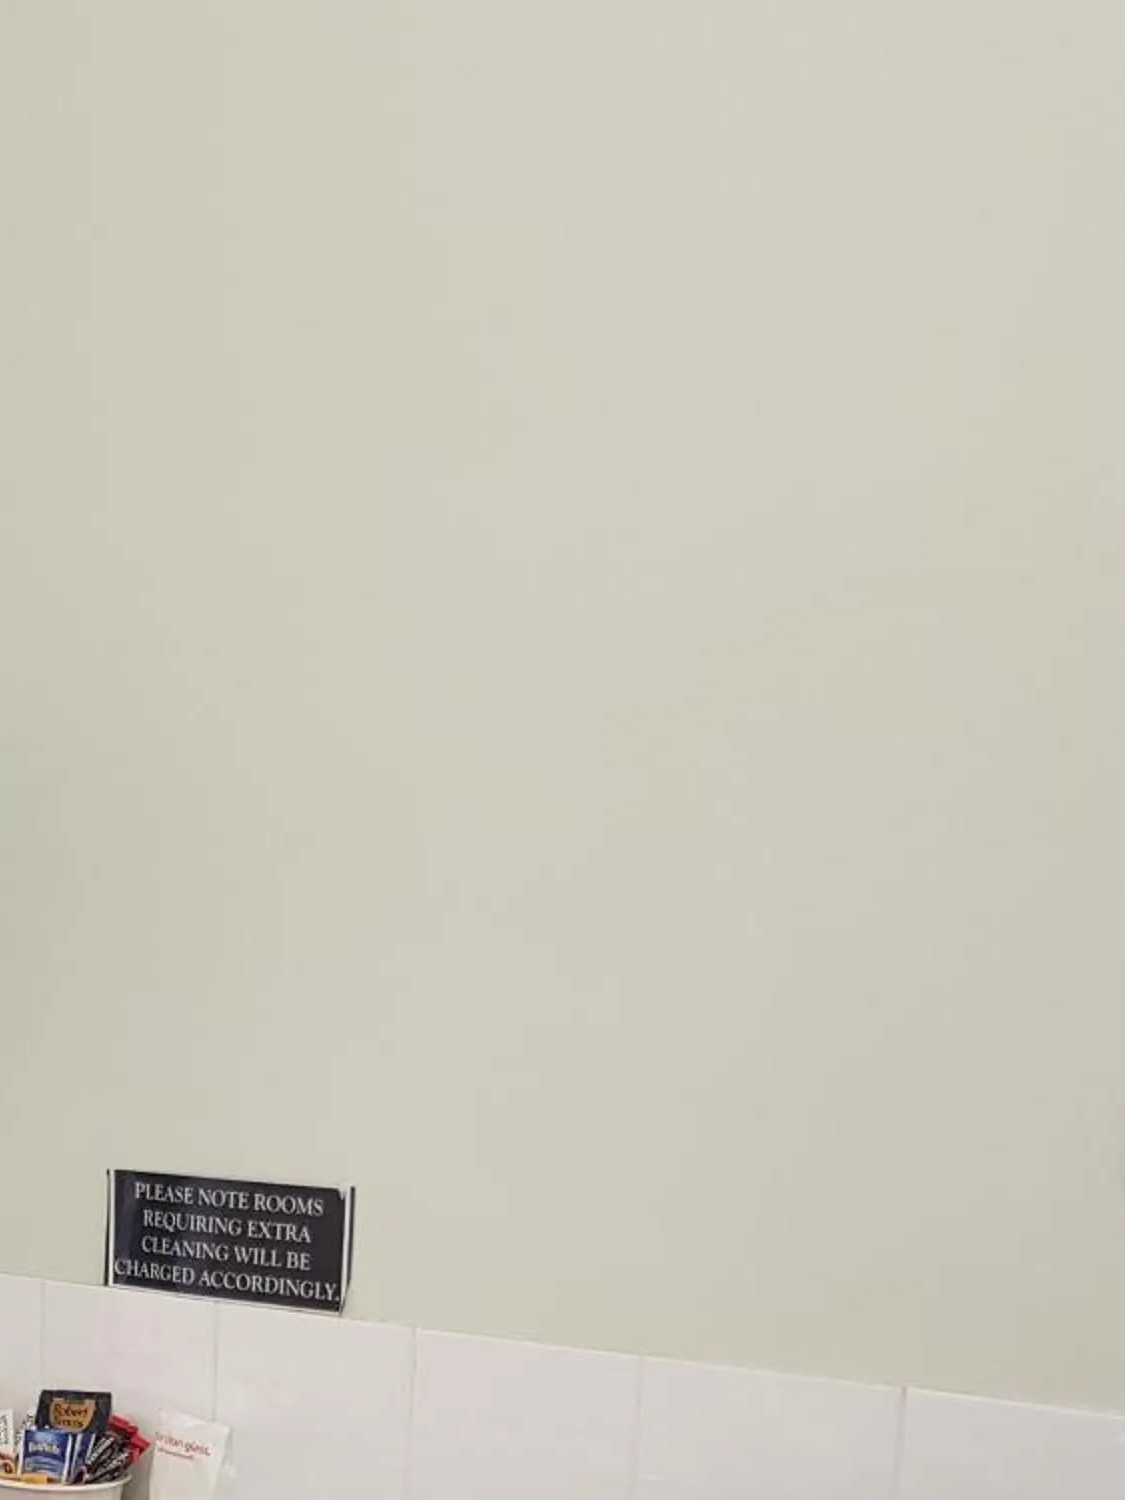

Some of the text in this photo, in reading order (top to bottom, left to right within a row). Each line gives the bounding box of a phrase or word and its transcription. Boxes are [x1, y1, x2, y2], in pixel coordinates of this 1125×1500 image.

[135, 1181, 324, 1217] PLEASE NOTE ROOMS
[143, 1209, 311, 1244] REQUIRING EXTRA
[142, 1236, 310, 1271] CLEANING WILL BE
[115, 1260, 340, 1301] CHARGED ACCORDINGLY.
